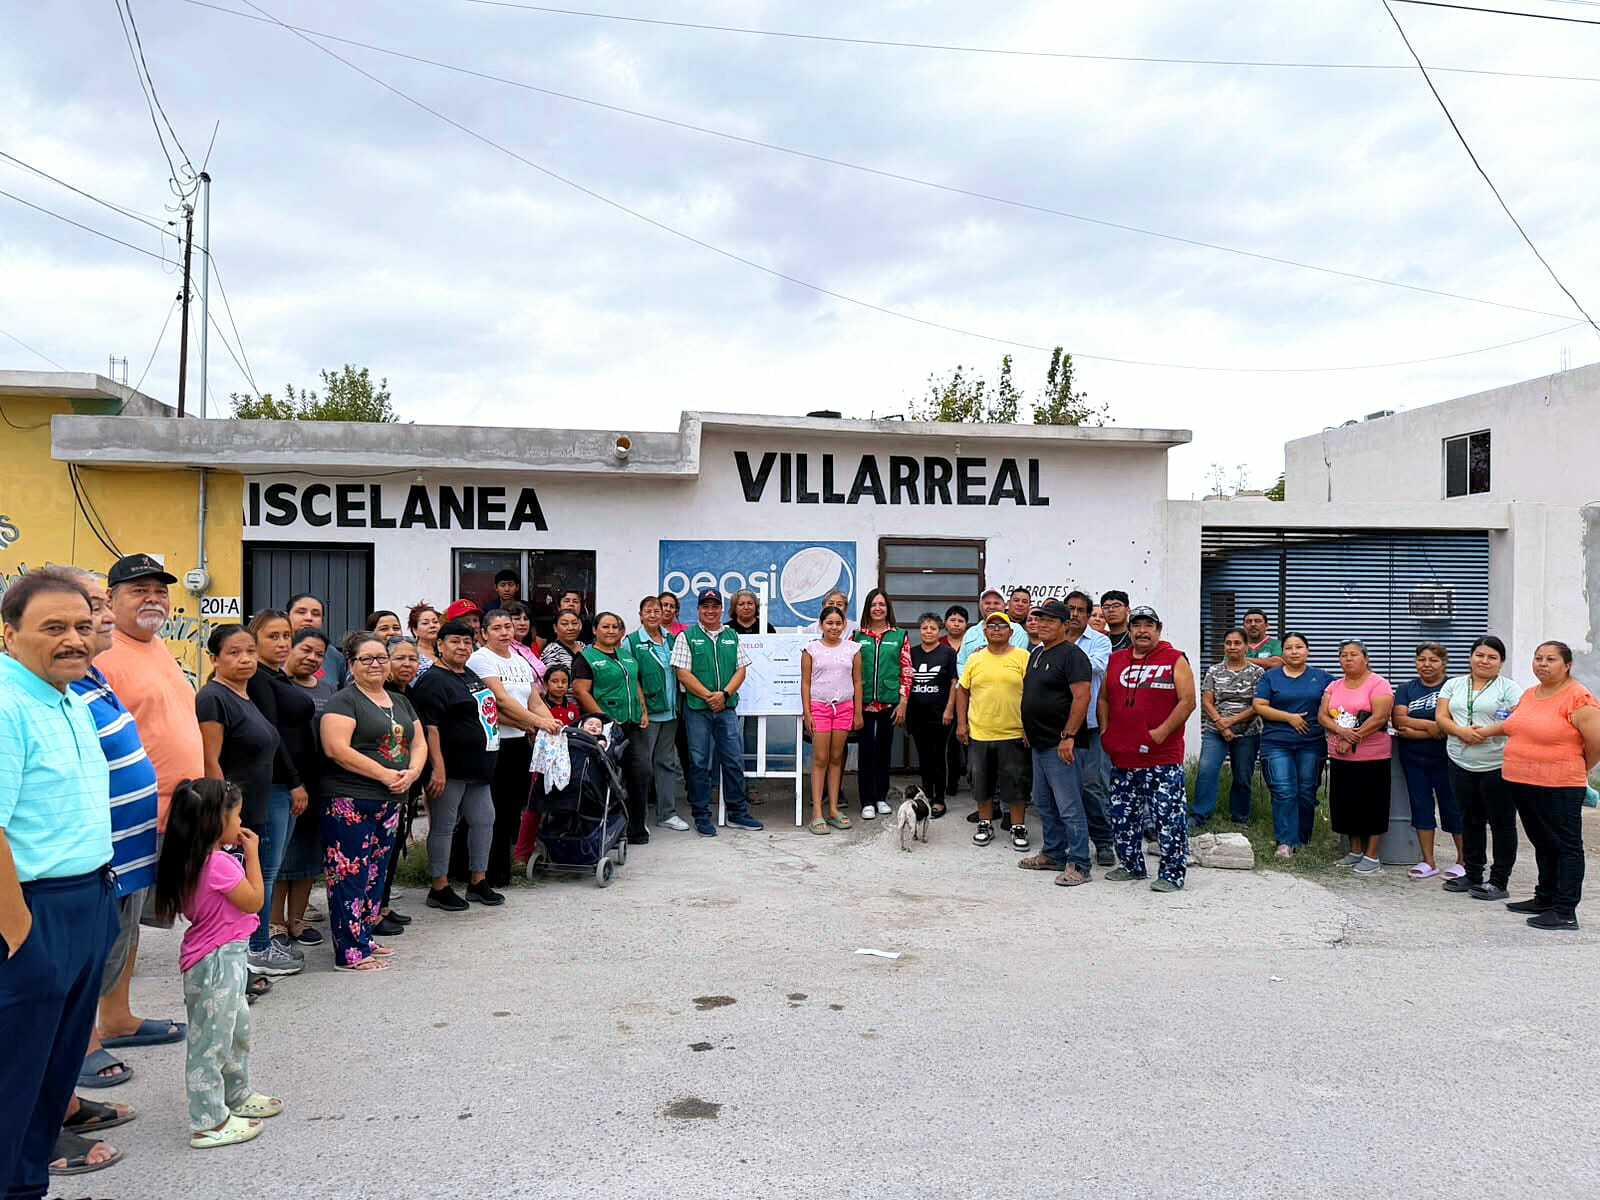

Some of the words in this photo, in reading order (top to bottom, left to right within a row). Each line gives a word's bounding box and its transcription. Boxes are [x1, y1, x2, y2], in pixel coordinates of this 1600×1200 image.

[733, 450, 1050, 506] VILLARREAL
[242, 482, 549, 531] ISCELANEA
[201, 598, 240, 615] 201-A
[911, 684, 940, 693] adidas
